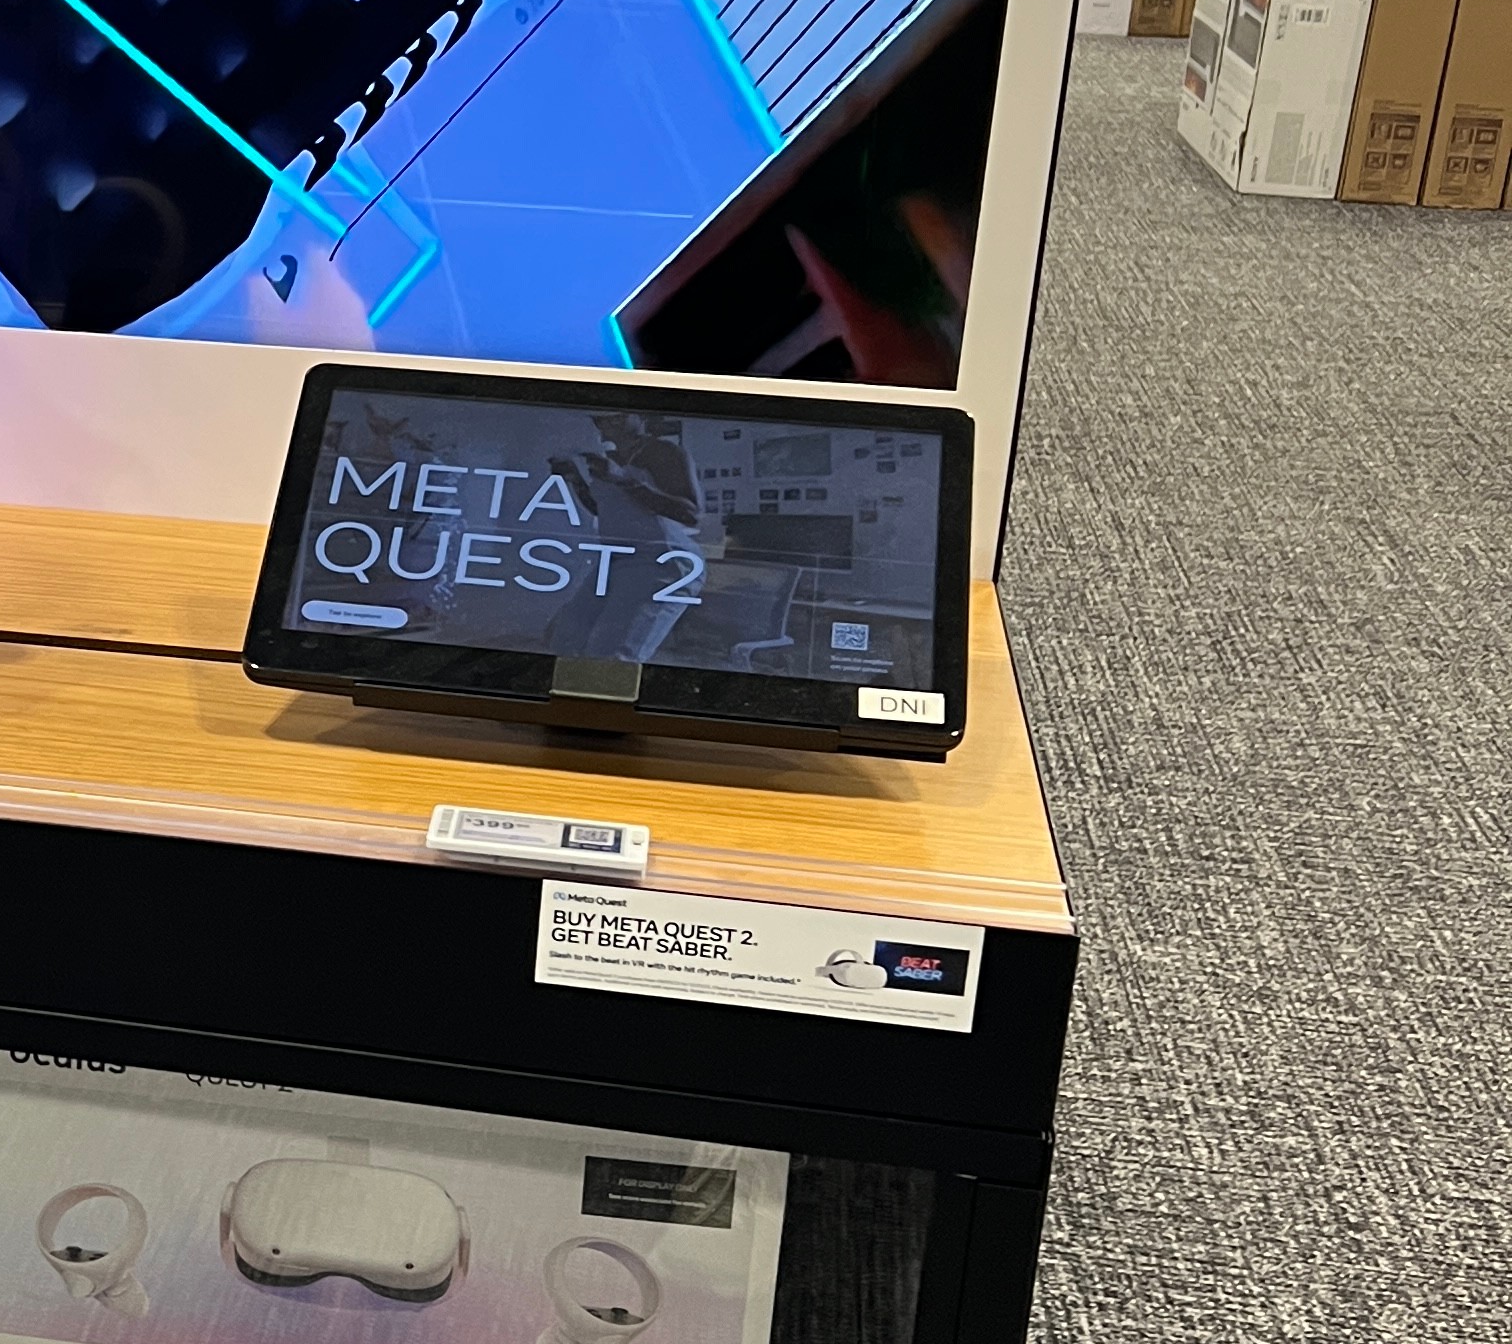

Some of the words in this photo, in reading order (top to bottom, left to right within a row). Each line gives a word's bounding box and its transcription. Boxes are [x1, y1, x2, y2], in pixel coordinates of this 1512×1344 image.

[327, 455, 583, 527] META
[314, 521, 636, 597] QUEST
[652, 551, 706, 605] 2
[880, 696, 926, 716] DNI
[567, 892, 594, 905] Meta
[595, 895, 627, 907] Quest
[553, 909, 596, 927] BUY
[600, 914, 659, 935] META
[664, 921, 737, 944] QUEST
[740, 930, 758, 946] 2.
[551, 927, 594, 945] GET
[598, 932, 653, 951] BEAT
[656, 938, 733, 961] SABER.
[601, 956, 620, 965] beat
[631, 959, 645, 967] VR
[647, 961, 666, 970] with
[668, 963, 682, 972] the
[683, 965, 695, 973] hit
[697, 967, 729, 977] rhythm
[730, 972, 755, 980] game
[894, 965, 943, 981] SABER
[900, 955, 941, 970] BEAT
